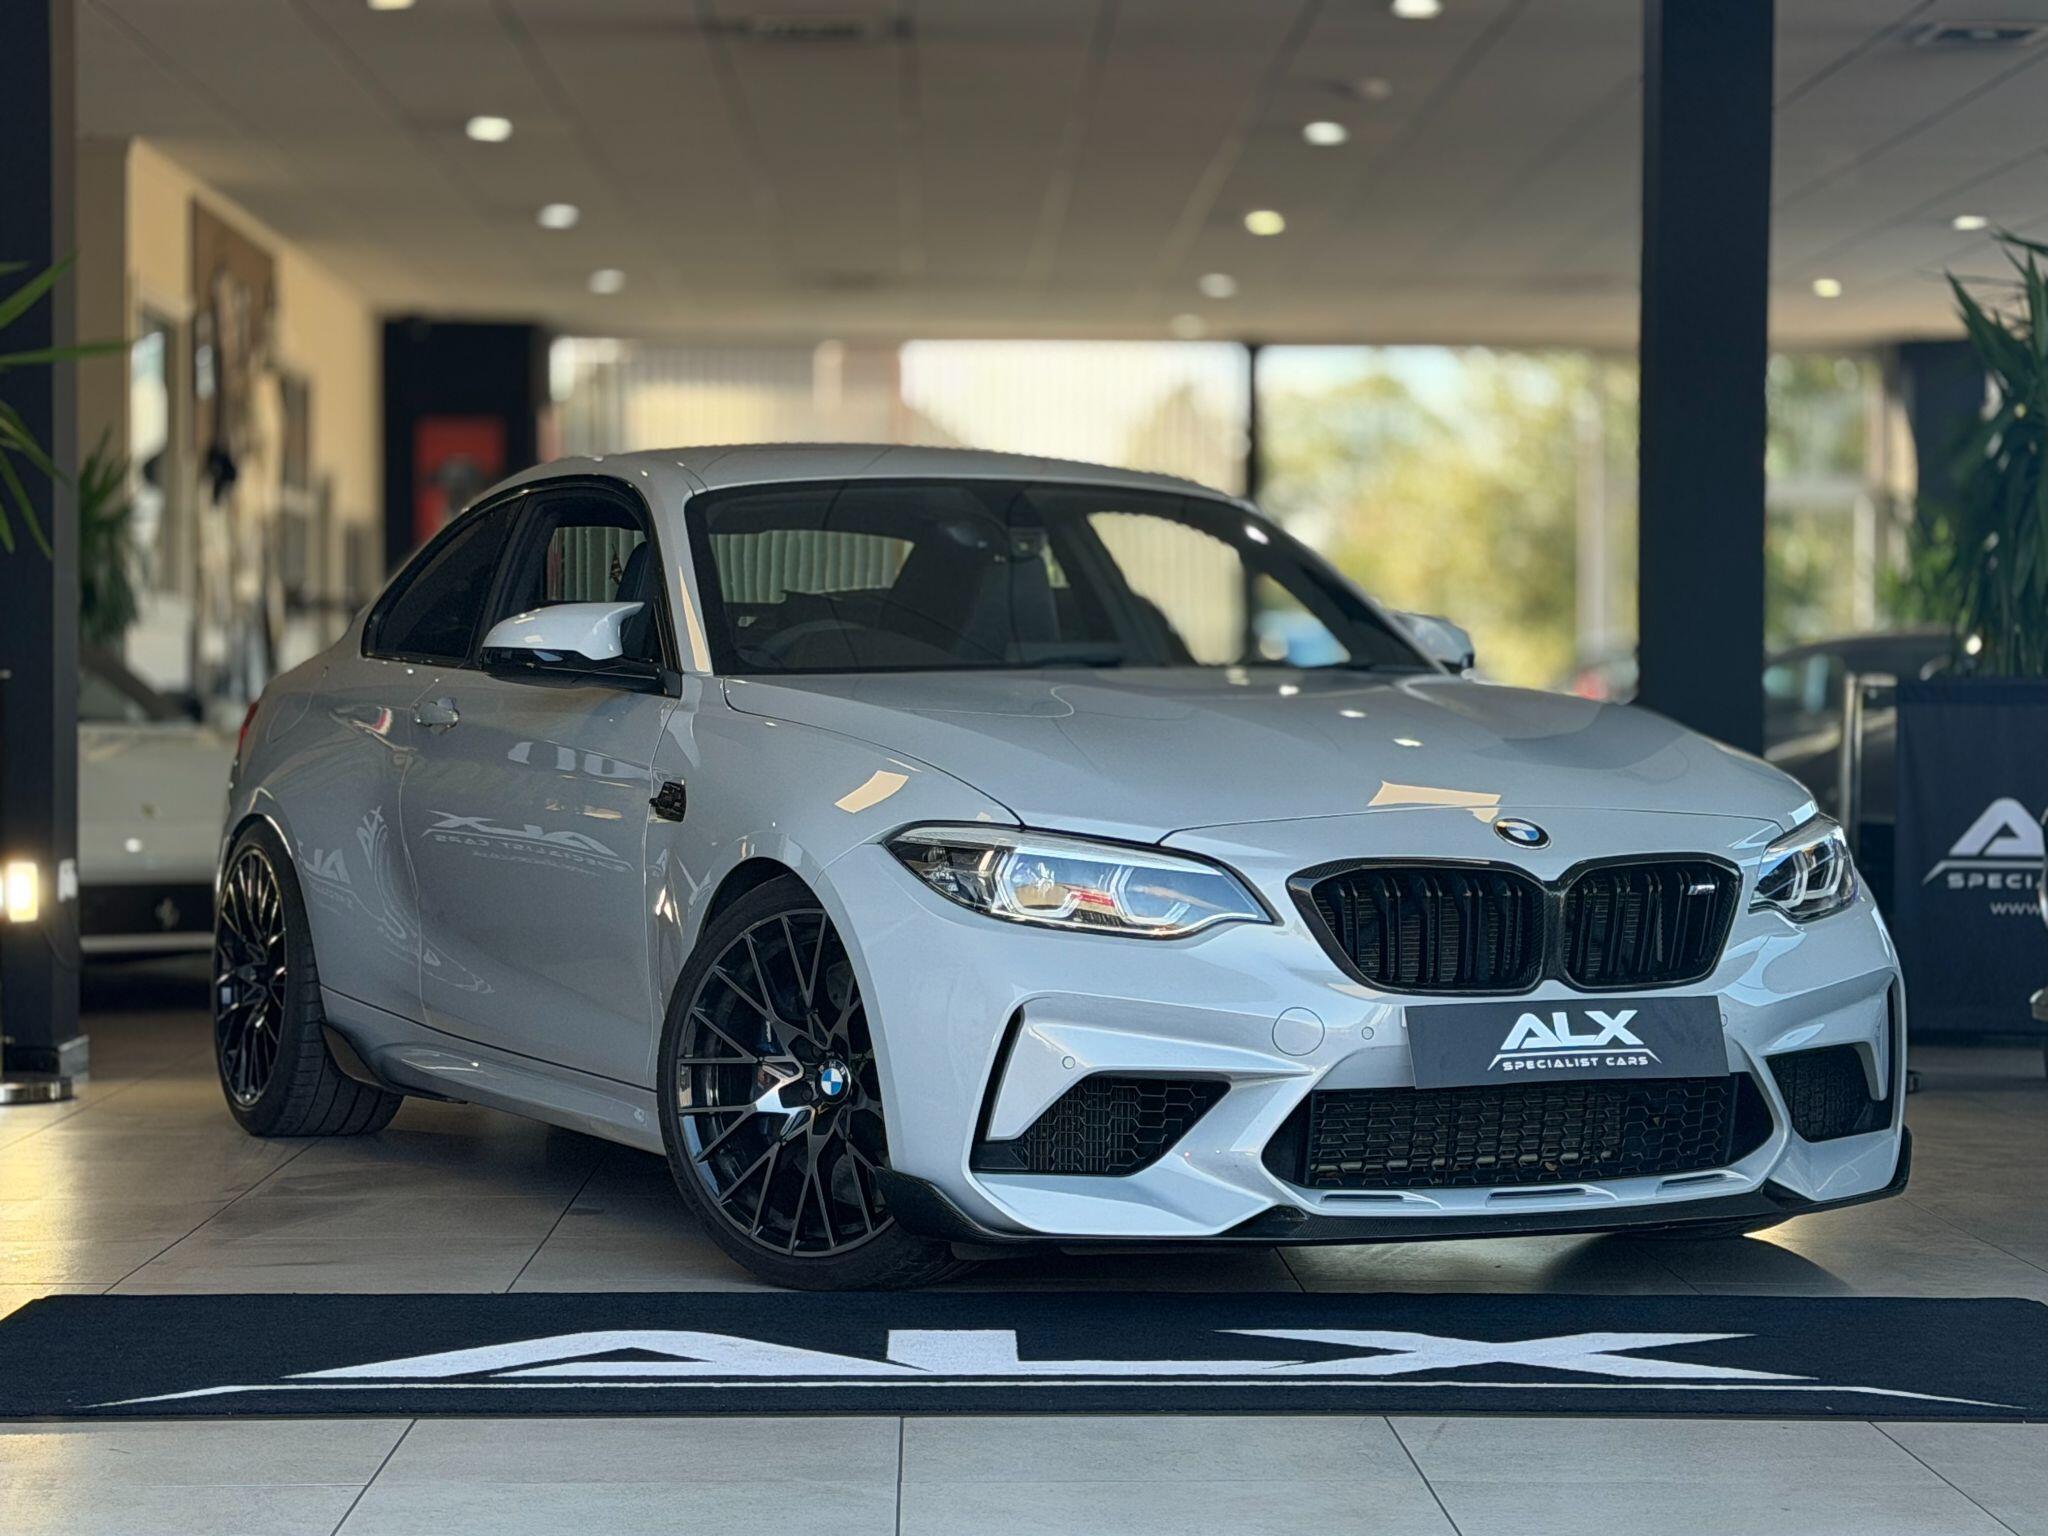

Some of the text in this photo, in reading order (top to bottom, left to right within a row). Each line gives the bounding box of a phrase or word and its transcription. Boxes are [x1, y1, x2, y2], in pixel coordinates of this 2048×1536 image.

[1501, 1009, 1645, 1051] ALX
[1502, 1056, 1649, 1072] SPECIALIST CARS
[281, 1328, 1819, 1380] ALX
